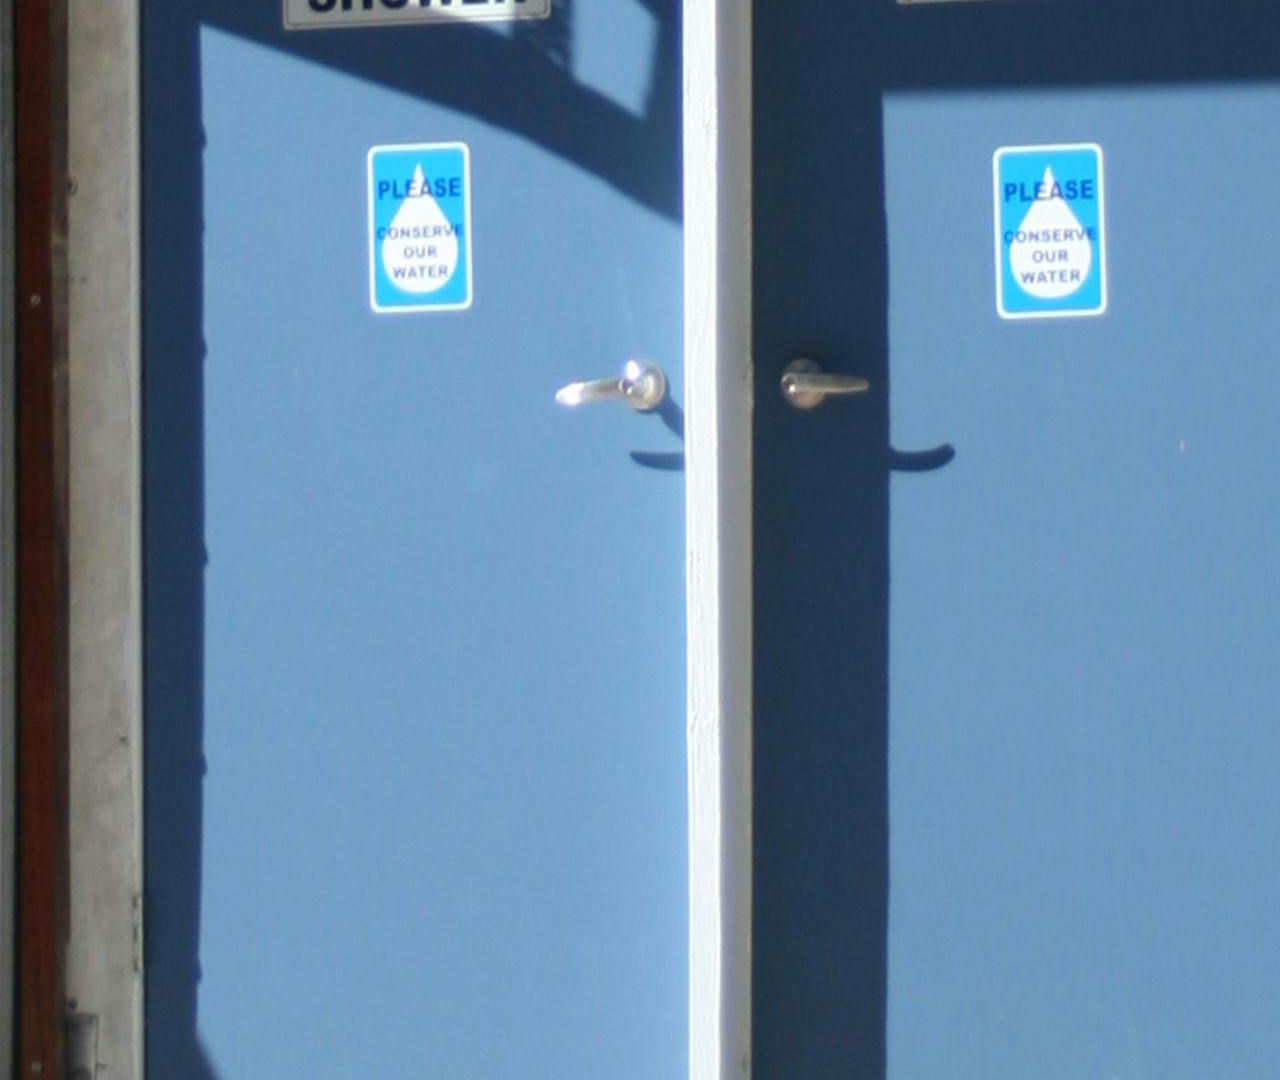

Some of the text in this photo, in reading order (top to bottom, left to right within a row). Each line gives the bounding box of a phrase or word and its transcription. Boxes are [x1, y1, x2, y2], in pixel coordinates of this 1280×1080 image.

[378, 177, 461, 200] PLEASE
[1004, 179, 1094, 202] PLEASE
[377, 224, 463, 240] CONSERVE
[1003, 227, 1096, 244] CONSERVE
[403, 245, 438, 259] OUR
[1031, 249, 1069, 263] OUR
[393, 265, 449, 279] WATER
[1020, 269, 1081, 284] WATER
